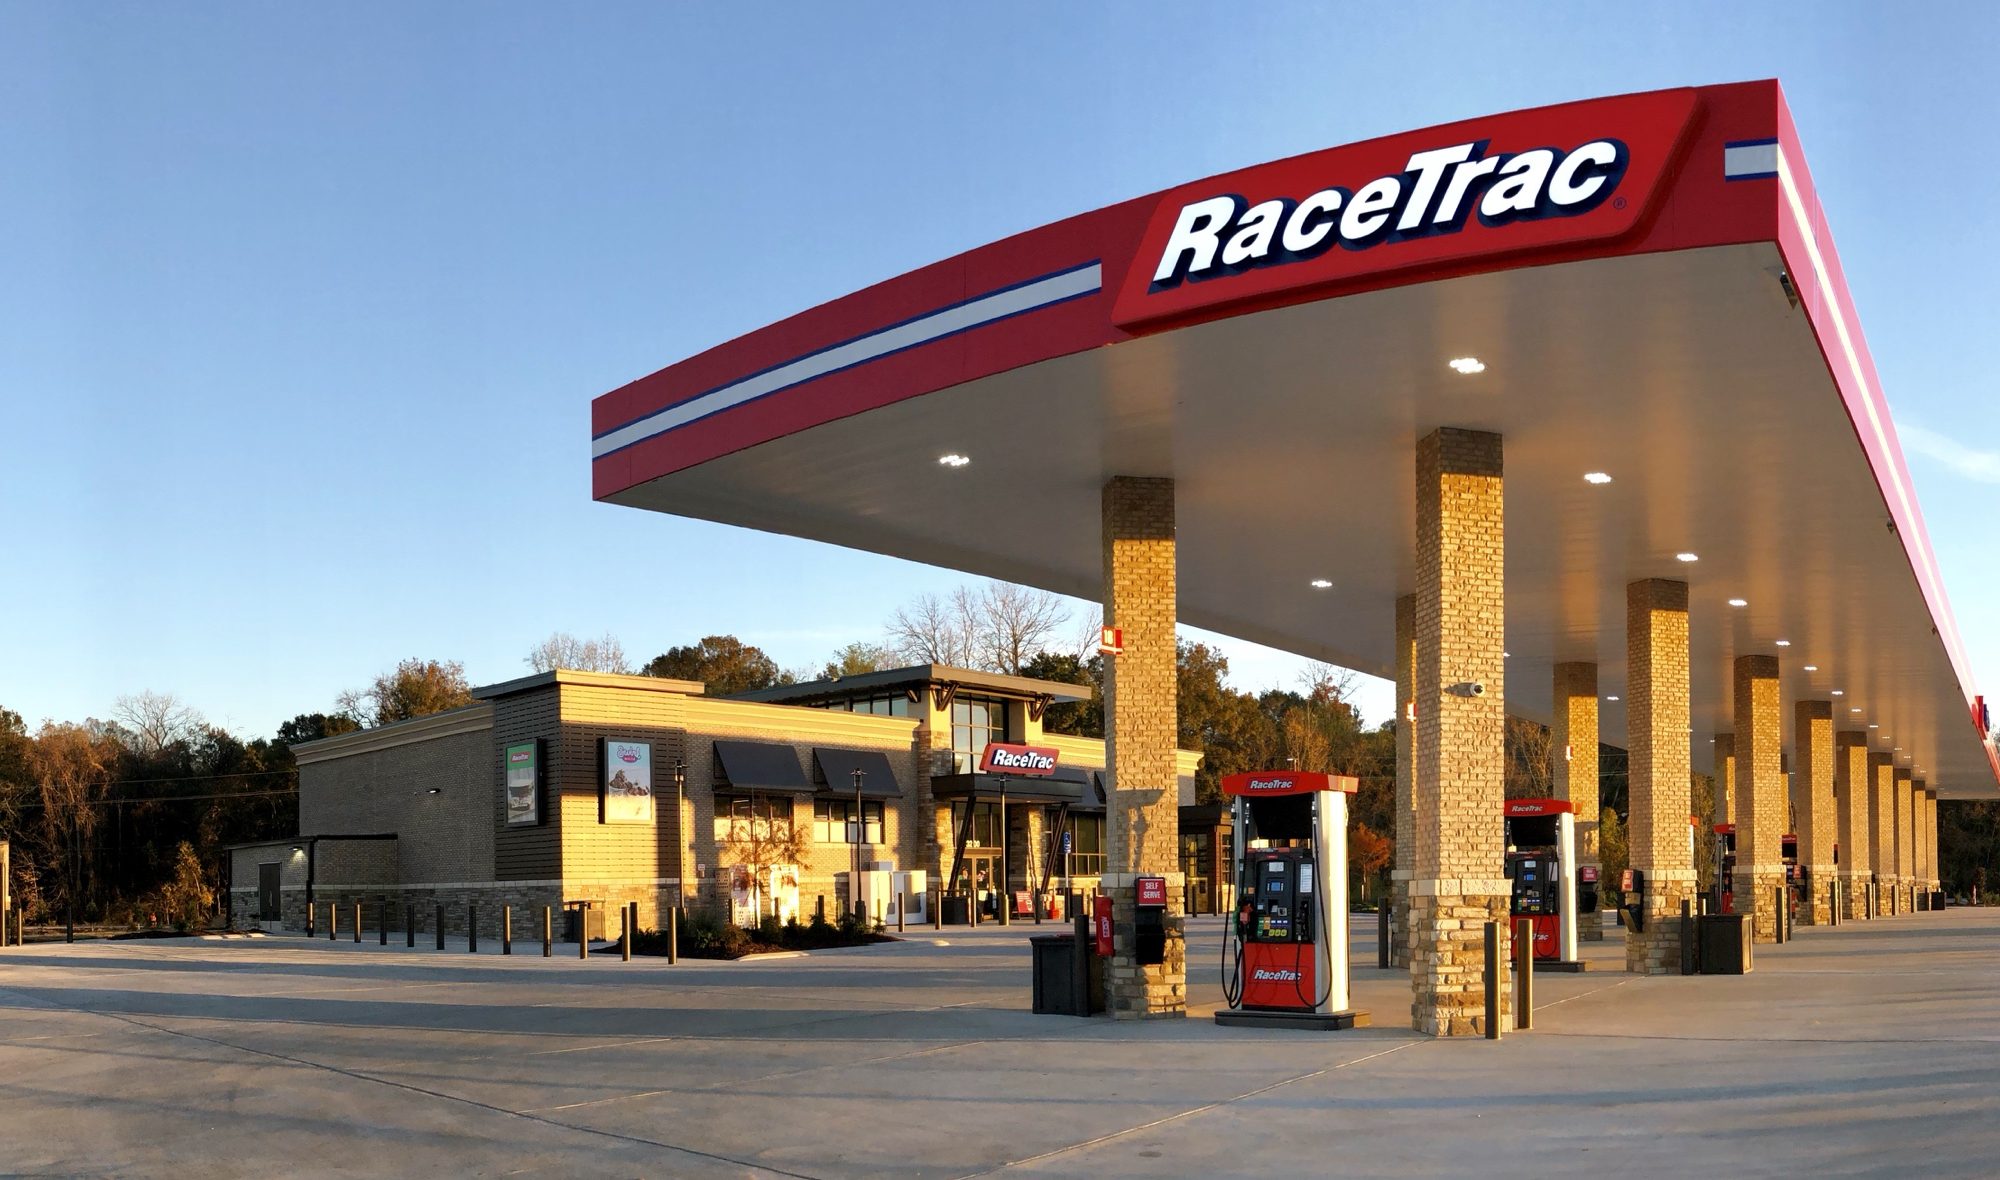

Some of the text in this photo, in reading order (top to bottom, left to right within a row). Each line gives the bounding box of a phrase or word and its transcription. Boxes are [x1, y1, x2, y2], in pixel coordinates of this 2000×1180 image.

[1149, 139, 1624, 289] RaceTrac
[992, 749, 1055, 769] RaceTrac
[1250, 779, 1293, 789] RaceTrac
[1145, 882, 1159, 890] SELF
[1143, 891, 1161, 899] SERVE
